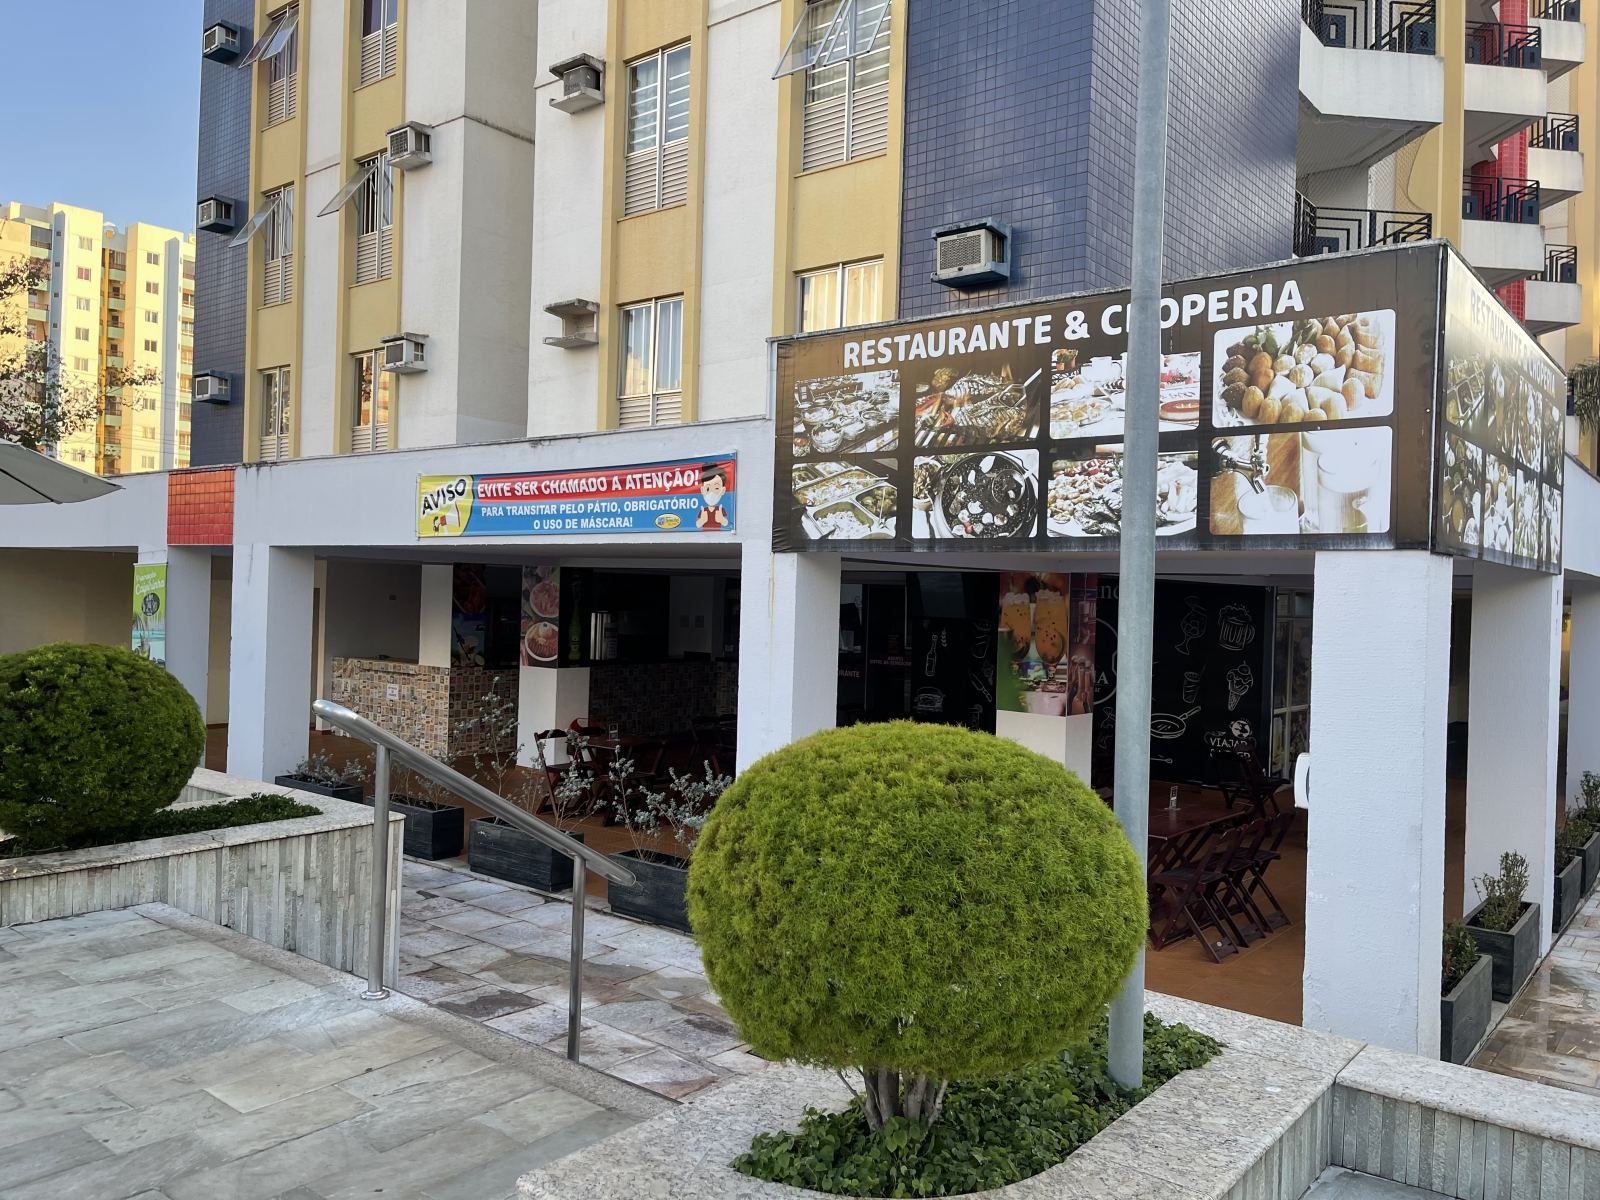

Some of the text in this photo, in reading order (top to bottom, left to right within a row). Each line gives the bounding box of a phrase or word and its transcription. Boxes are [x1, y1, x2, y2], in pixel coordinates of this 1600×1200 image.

[843, 279, 1305, 369] RESTAURANTE & COPERIA
[422, 478, 467, 516] AVISO
[477, 468, 699, 498] EVITE SER CHAMADO A ATENÇÃO!
[481, 497, 698, 517] PARA TRANSITAR PELO PÁTIO, OBRIGATÓRIO
[533, 516, 633, 530] O USO DE MÁSCARA!
